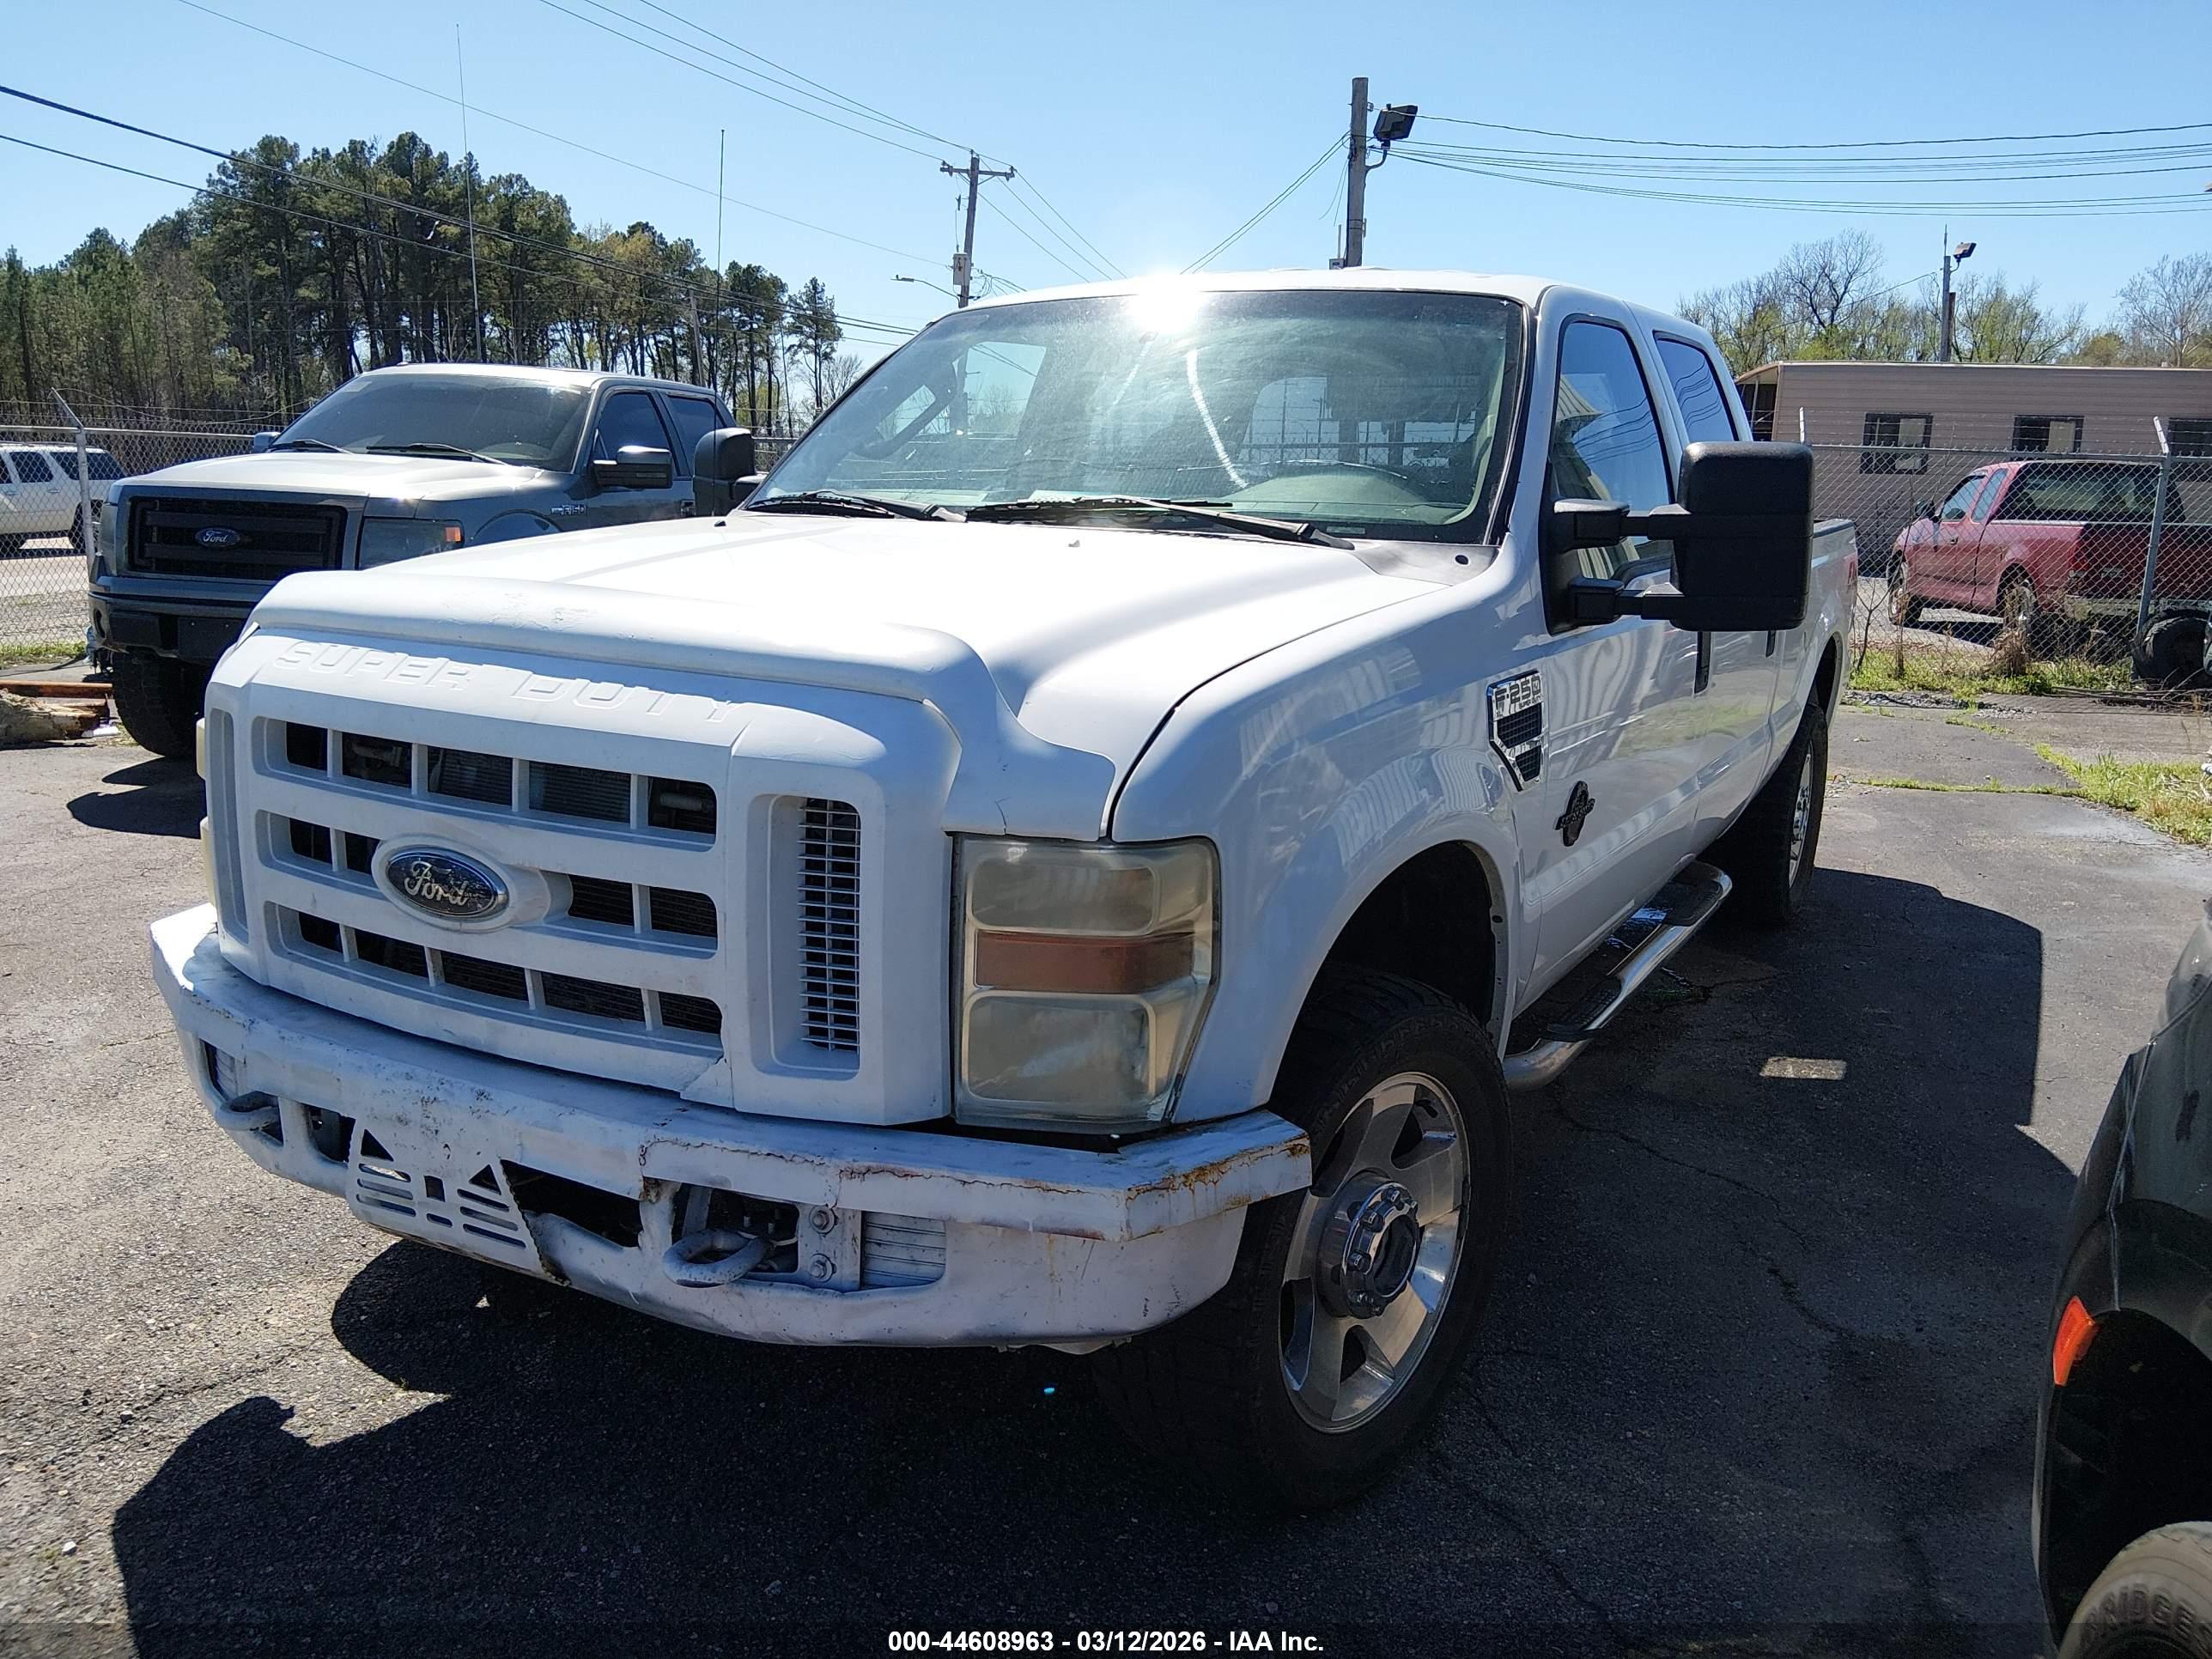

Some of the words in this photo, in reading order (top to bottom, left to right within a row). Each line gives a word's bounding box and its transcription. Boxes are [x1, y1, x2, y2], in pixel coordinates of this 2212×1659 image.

[203, 529, 228, 543] Ford
[273, 641, 471, 692] SUPER
[511, 671, 738, 723] DUTY
[1495, 675, 1541, 710] F-250
[404, 858, 470, 907] Ford
